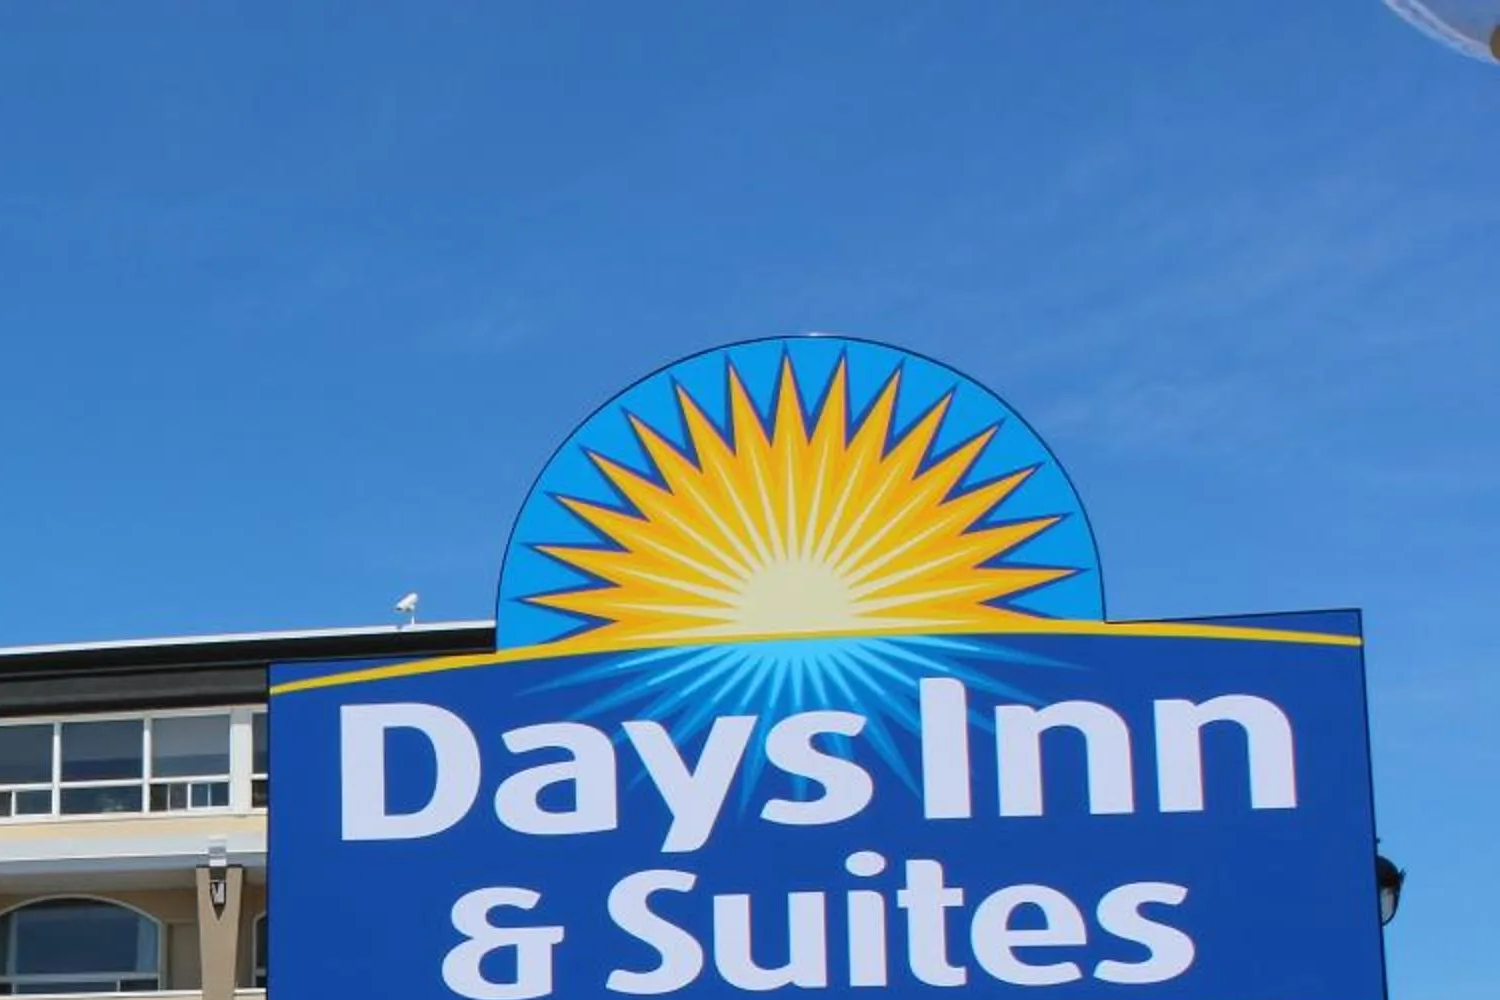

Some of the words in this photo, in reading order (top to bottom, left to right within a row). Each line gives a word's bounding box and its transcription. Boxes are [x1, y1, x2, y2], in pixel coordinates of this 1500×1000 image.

[339, 700, 875, 853] Days
[919, 676, 1298, 820] Inn
[605, 850, 1196, 996] Suites
